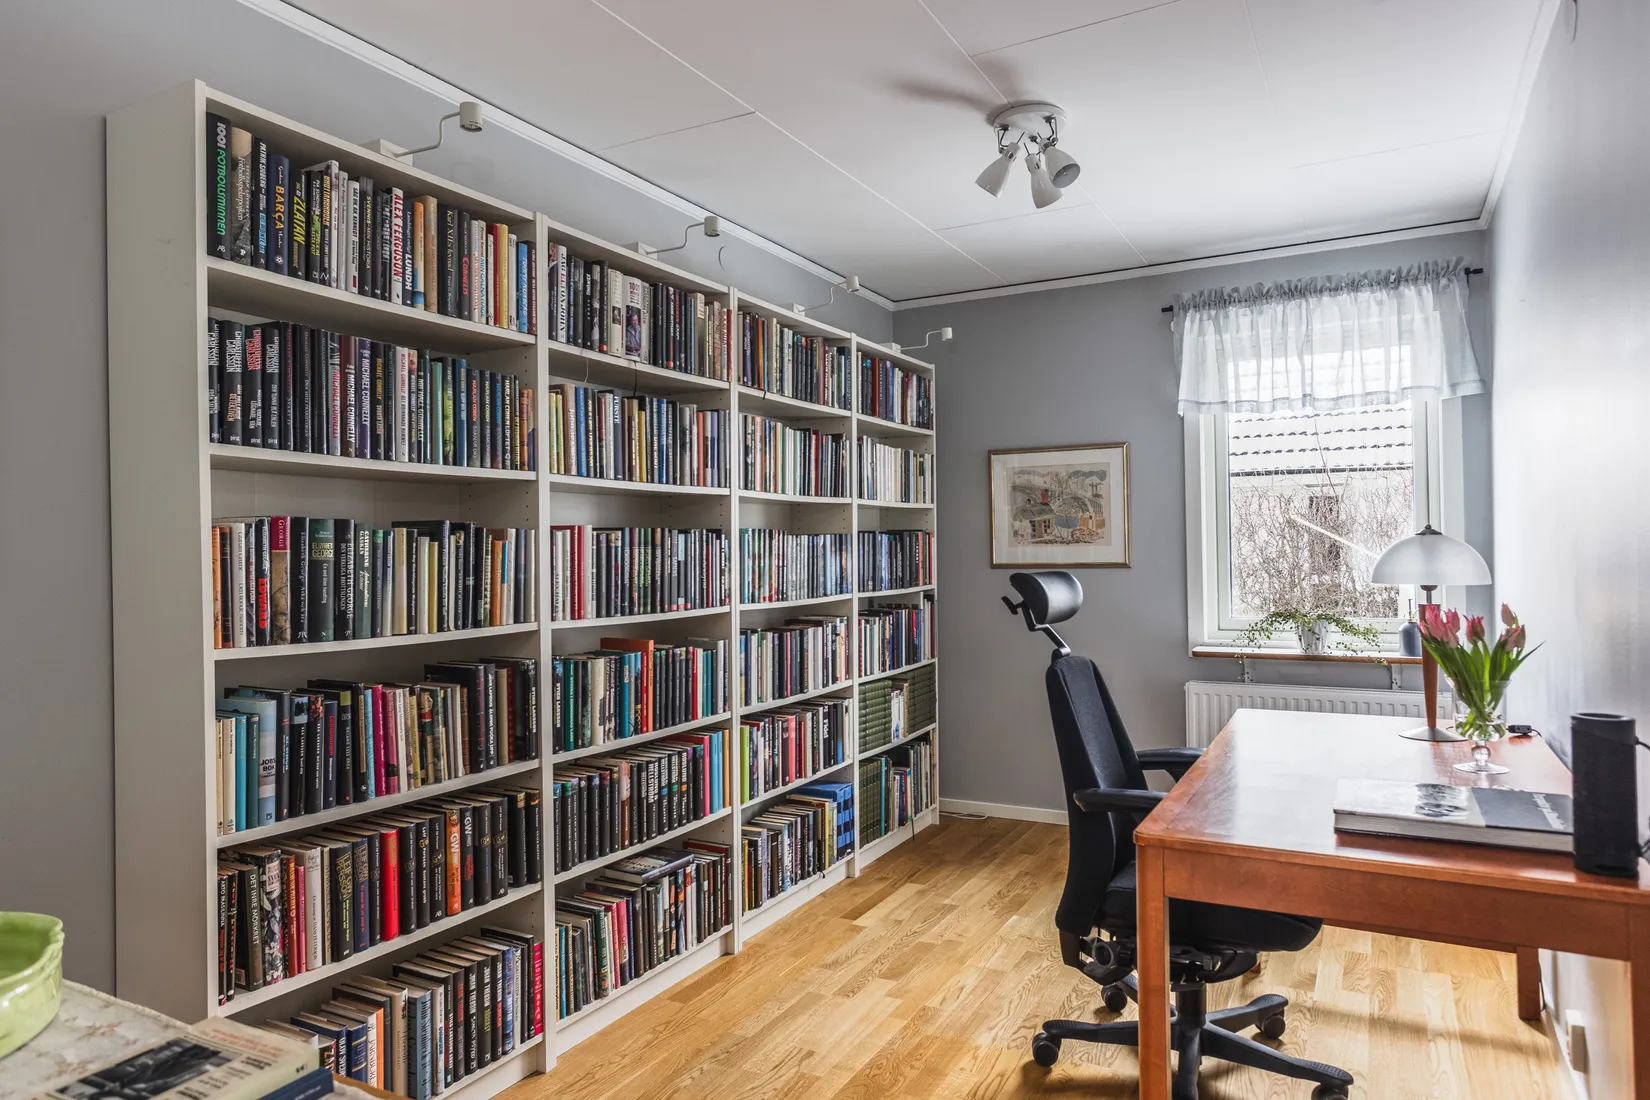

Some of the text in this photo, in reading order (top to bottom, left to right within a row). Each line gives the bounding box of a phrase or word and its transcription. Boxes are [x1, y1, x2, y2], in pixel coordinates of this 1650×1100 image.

[217, 122, 226, 235] 1001 FOTBOLLSMINNEN
[272, 185, 284, 229] BARÇA
[293, 196, 306, 244] ZLATAN
[394, 194, 403, 278] ALEX FERGUSON
[226, 340, 236, 372] CARLSSON
[246, 338, 256, 370] CARLSSON
[266, 344, 274, 373] CARLSSON
[347, 374, 355, 442] MICHAEL CONNELLY
[362, 358, 370, 426] MICHAEL CONNELLY
[258, 578, 268, 629] EDWARD
[465, 816, 472, 834] GW
[336, 860, 347, 898] PERSSON
[344, 856, 352, 876] LEIF
[252, 909, 260, 945] MÖRKRET
